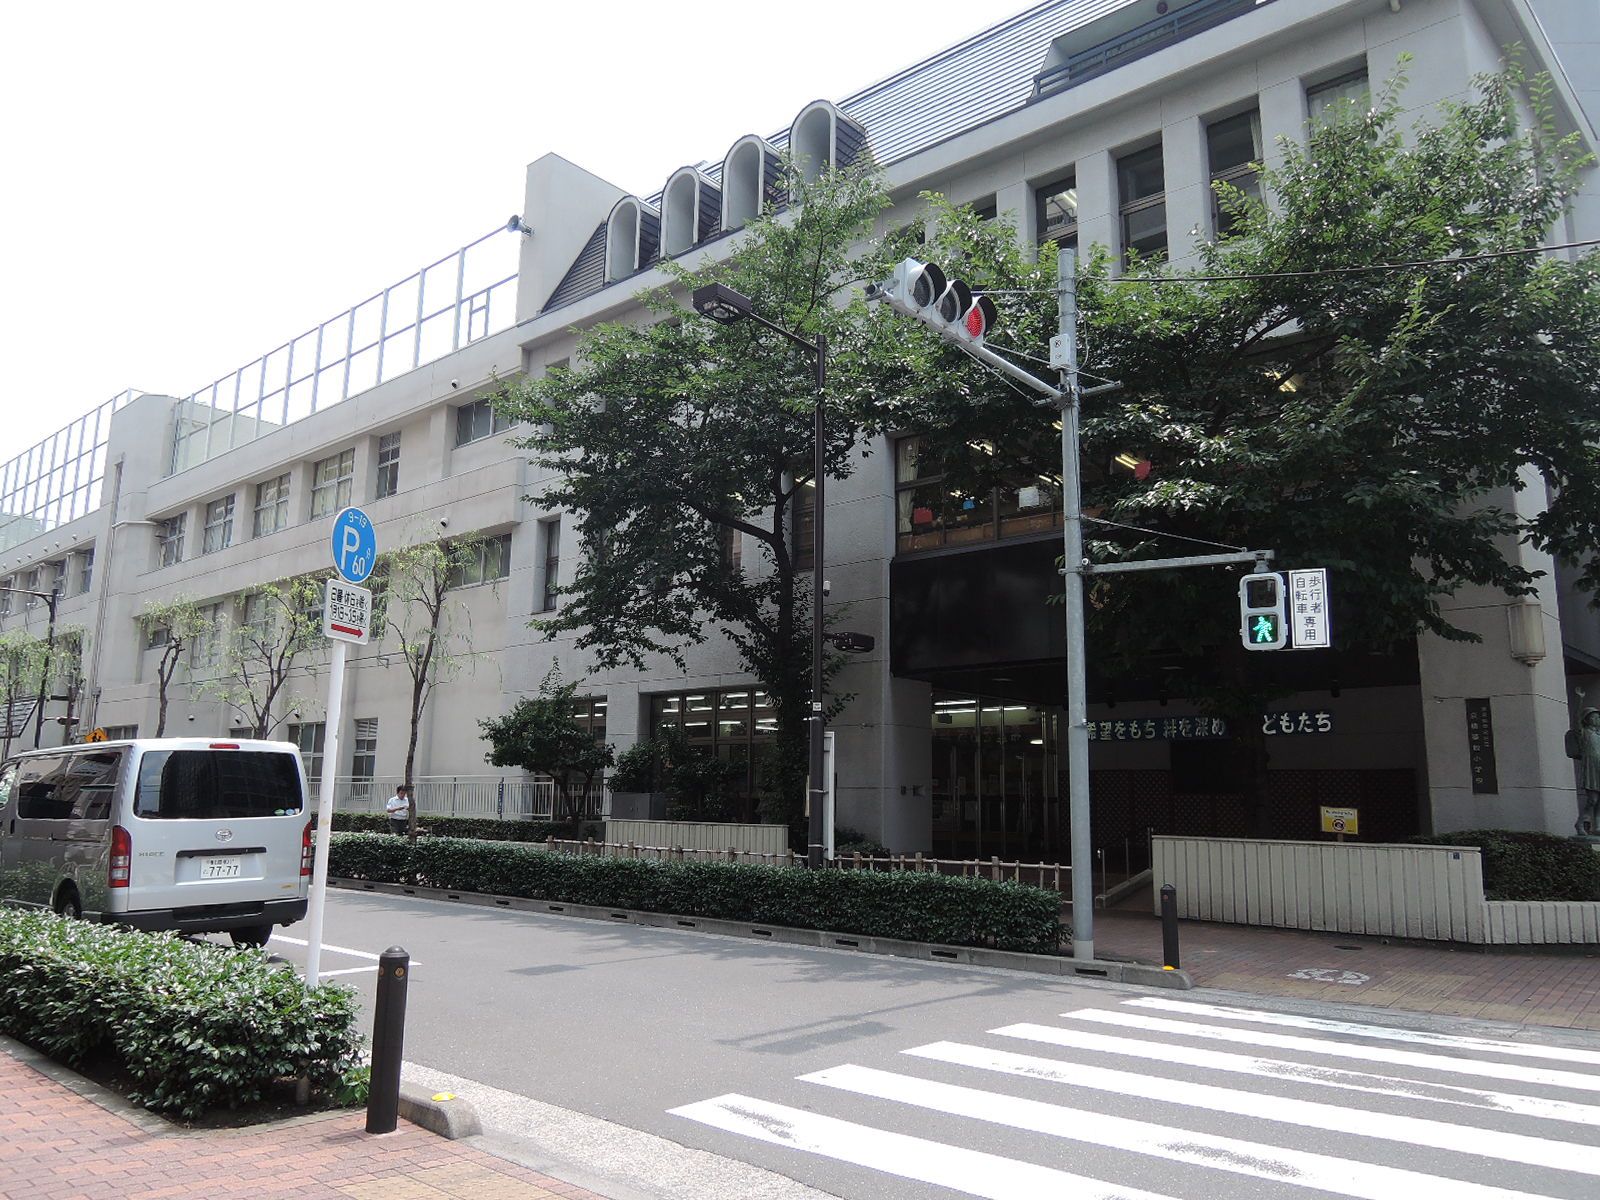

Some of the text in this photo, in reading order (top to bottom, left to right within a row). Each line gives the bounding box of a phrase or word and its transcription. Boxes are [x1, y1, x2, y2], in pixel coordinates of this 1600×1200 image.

[340, 525, 360, 571] P
[1295, 577, 1308, 614] 自転車
[1308, 576, 1323, 614] 歩行者
[1304, 616, 1317, 641] 専用
[1087, 711, 1332, 741] 希望をもち 絆を深め どもたち
